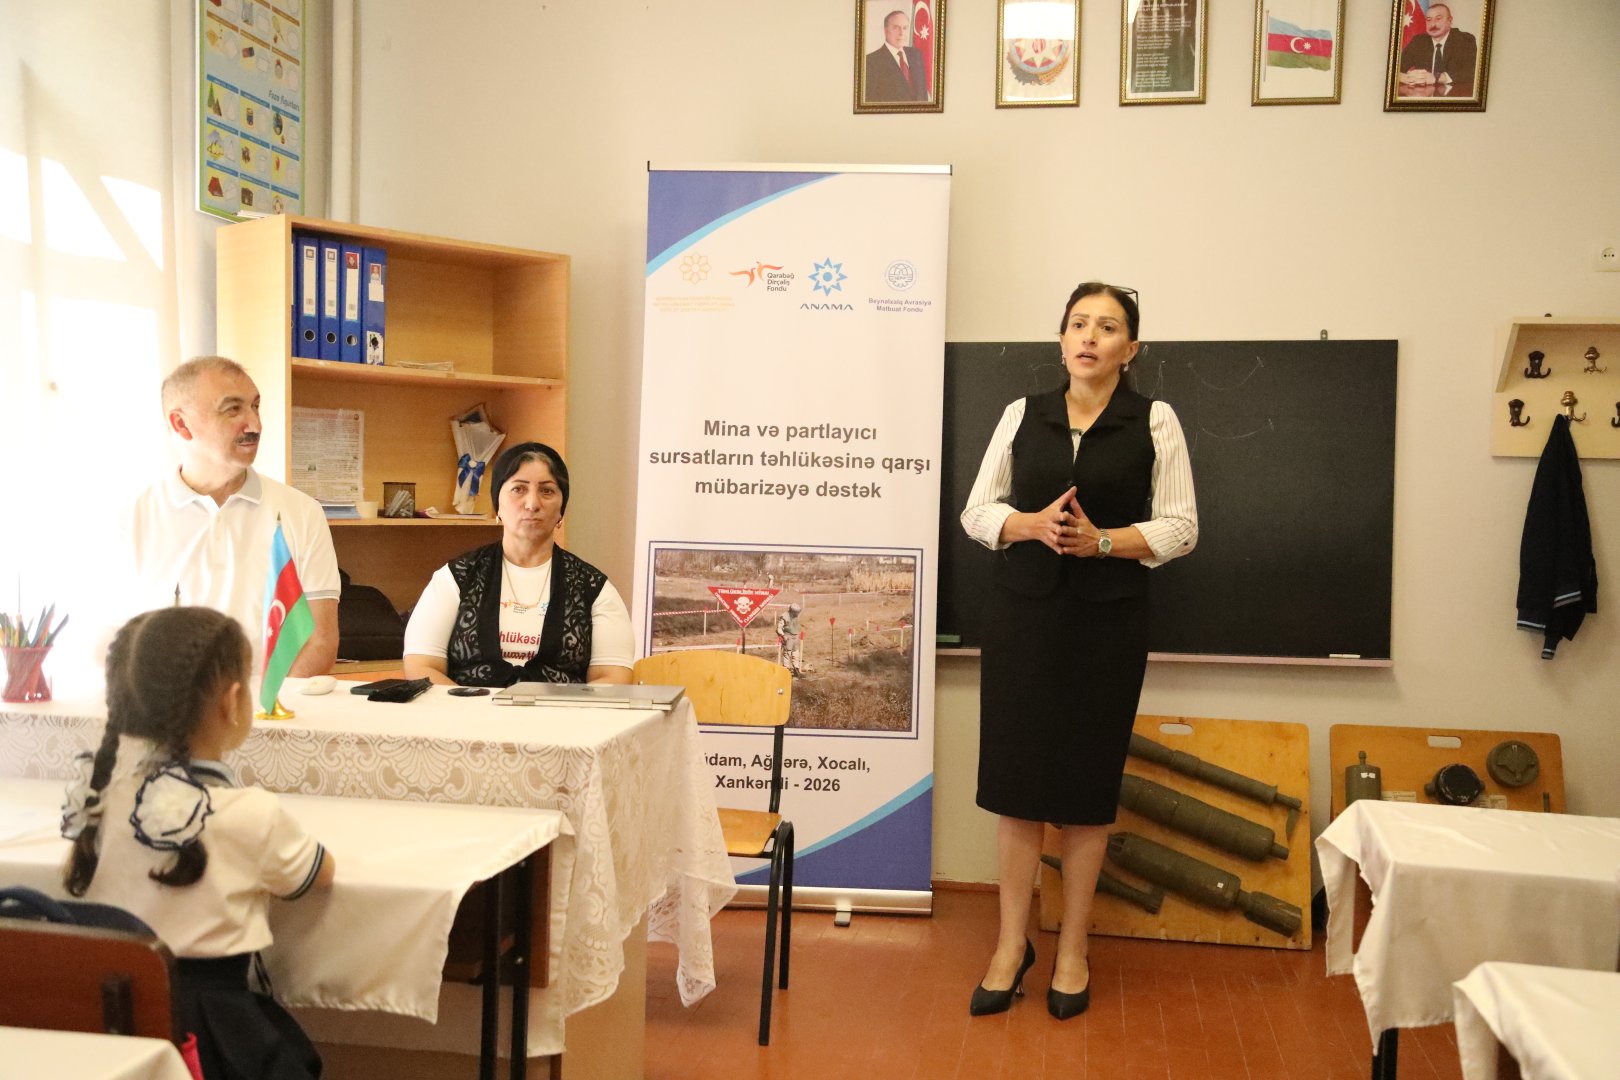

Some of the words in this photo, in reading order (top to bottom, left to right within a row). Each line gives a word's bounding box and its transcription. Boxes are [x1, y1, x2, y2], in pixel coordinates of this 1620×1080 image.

[800, 303, 854, 311] ANAMA
[703, 420, 750, 437] Mina
[757, 425, 780, 437] və
[786, 423, 877, 443] partlayıcı
[649, 449, 754, 466] sursatların
[760, 451, 875, 468] təhlükəsinə
[881, 456, 931, 474] qarşı
[695, 478, 809, 500] mübarizəyə
[815, 481, 882, 498] dəstək
[751, 754, 812, 771] Ağərə,
[817, 756, 871, 773] Xocalı,
[715, 774, 788, 790] Xankəni
[803, 778, 841, 792] 2026
